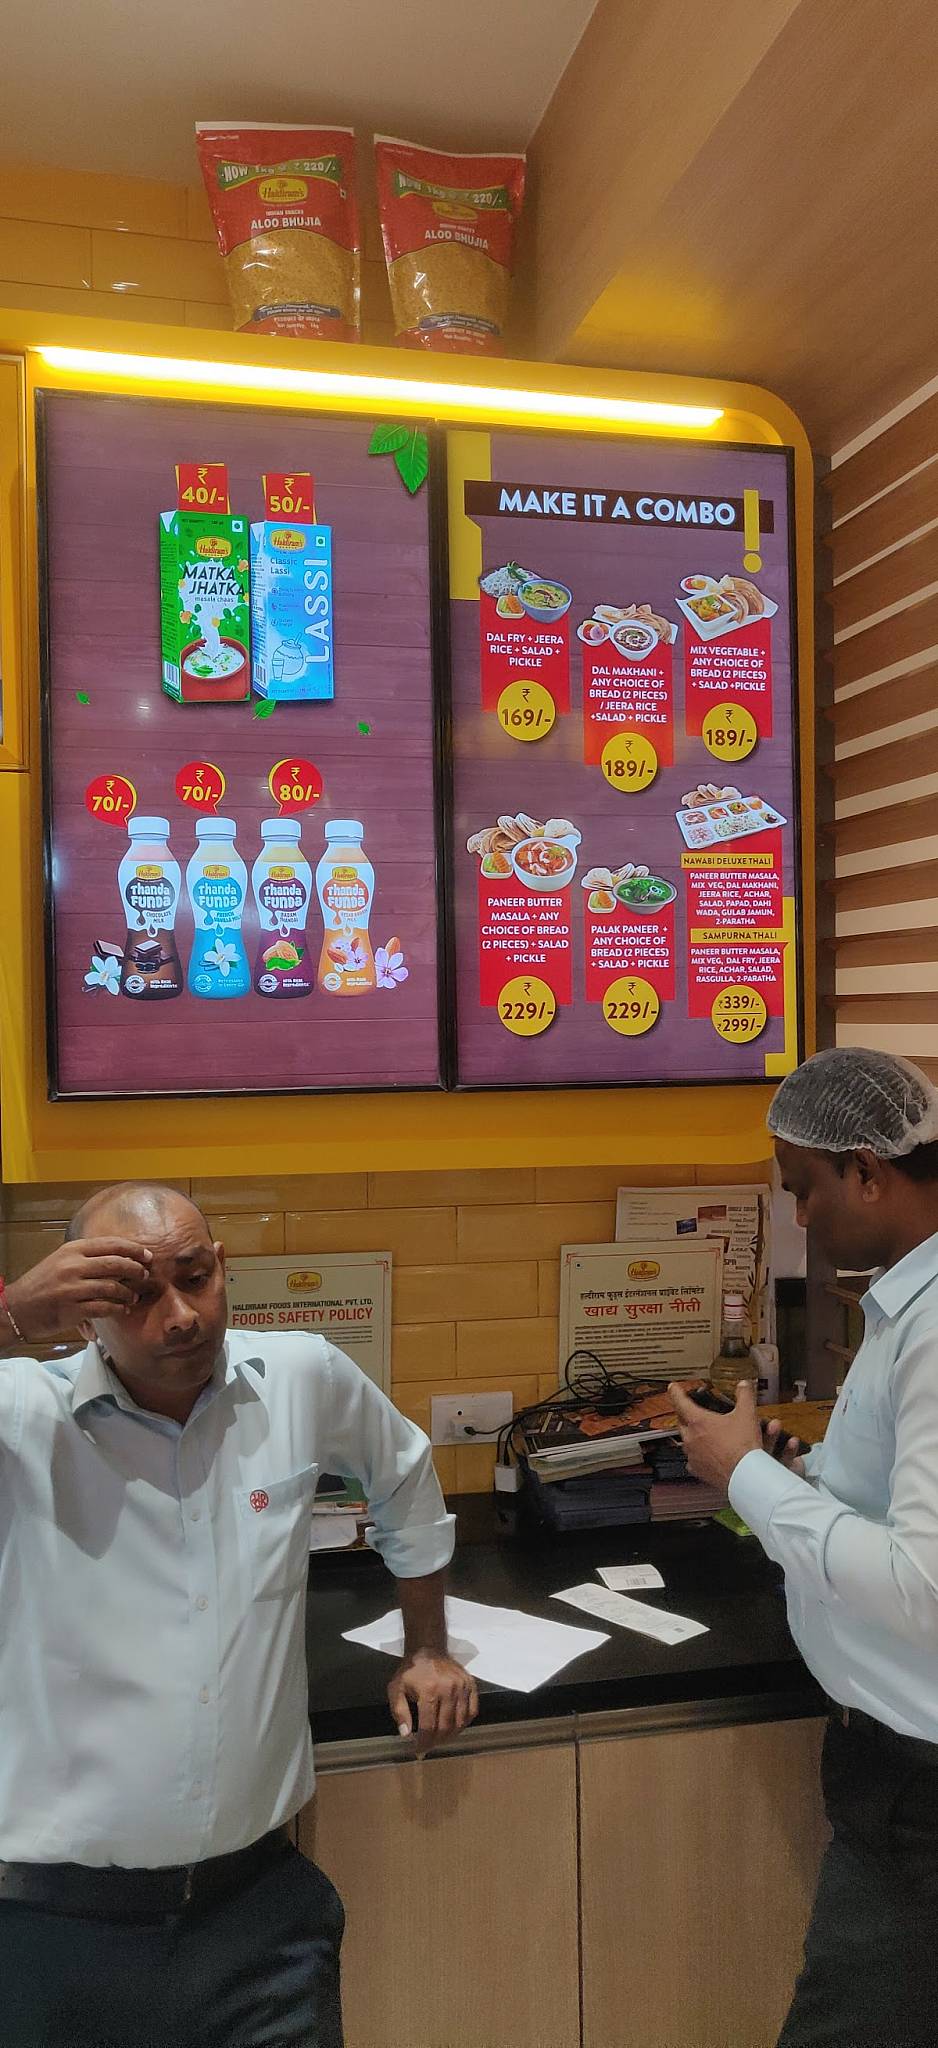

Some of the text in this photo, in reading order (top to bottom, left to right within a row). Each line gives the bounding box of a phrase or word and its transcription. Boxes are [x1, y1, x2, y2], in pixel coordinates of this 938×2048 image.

[224, 166, 249, 182] NOW
[251, 217, 321, 230] ALOO BHUJIA
[425, 230, 488, 249] ALOO BHUJIA
[181, 486, 224, 504] 40/-
[269, 496, 310, 513] 50/-
[499, 488, 577, 516] MAKE
[584, 494, 606, 516] IT
[611, 496, 631, 519] A
[636, 498, 736, 526] COMBO
[270, 557, 298, 565] Classic
[183, 564, 235, 580] MATKA
[270, 566, 290, 575] Lassi
[189, 581, 245, 596] JHATKA
[304, 559, 331, 663] LASSI
[486, 632, 564, 644] DAL FRY JEERA
[490, 645, 553, 655] RICE SALAD
[690, 646, 759, 657] MIX VEGETABLE
[509, 657, 543, 667] PICKLE
[692, 658, 764, 668] ANY CHOICE OF
[591, 666, 656, 676] DAL MAKHANI
[690, 669, 722, 678] BREAD
[732, 670, 767, 680] PIECES)
[591, 678, 665, 688] ANY CHOICE OF
[699, 681, 728, 690] SALAD
[589, 690, 621, 698] BREAD
[633, 691, 668, 700] PIECES)
[605, 702, 634, 711] JEERA
[635, 702, 657, 711] RICE
[501, 708, 552, 726] 169/-
[635, 714, 667, 723] PICKLE
[706, 729, 753, 747] 189/-
[604, 759, 654, 777] 189/-
[182, 785, 219, 801] 70/-
[279, 785, 320, 801] 80/-
[92, 796, 129, 812] 70/-
[131, 883, 169, 895] Thanda
[199, 883, 236, 894] Thanda
[264, 883, 302, 895] Thanda
[327, 884, 364, 896] Thanda
[487, 898, 562, 907] PANEER BUTTER
[491, 912, 559, 921] MASALA ANY
[482, 926, 569, 935] CHOICE OF BREAD
[591, 925, 659, 934] PALAK PANEER
[493, 940, 529, 950] PIECES)
[538, 940, 569, 949] SALAD
[592, 937, 666, 946] ANY CHOICE OF
[513, 954, 546, 963] PICKLE
[591, 948, 623, 957] BREAD
[634, 948, 669, 958] PIECES)
[598, 960, 669, 968] SALAD PICKLE
[502, 1002, 554, 1019] 229/-
[607, 1002, 657, 1019] 229/-
[232, 1303, 267, 1311] HALDIRAM
[269, 1302, 291, 1310] FOODS
[293, 1300, 344, 1308] INTERNATIONAL
[583, 1297, 701, 1319] खाद्य सुरक्षा नीती
[232, 1307, 373, 1326] FOODS SAFETY POLICY
